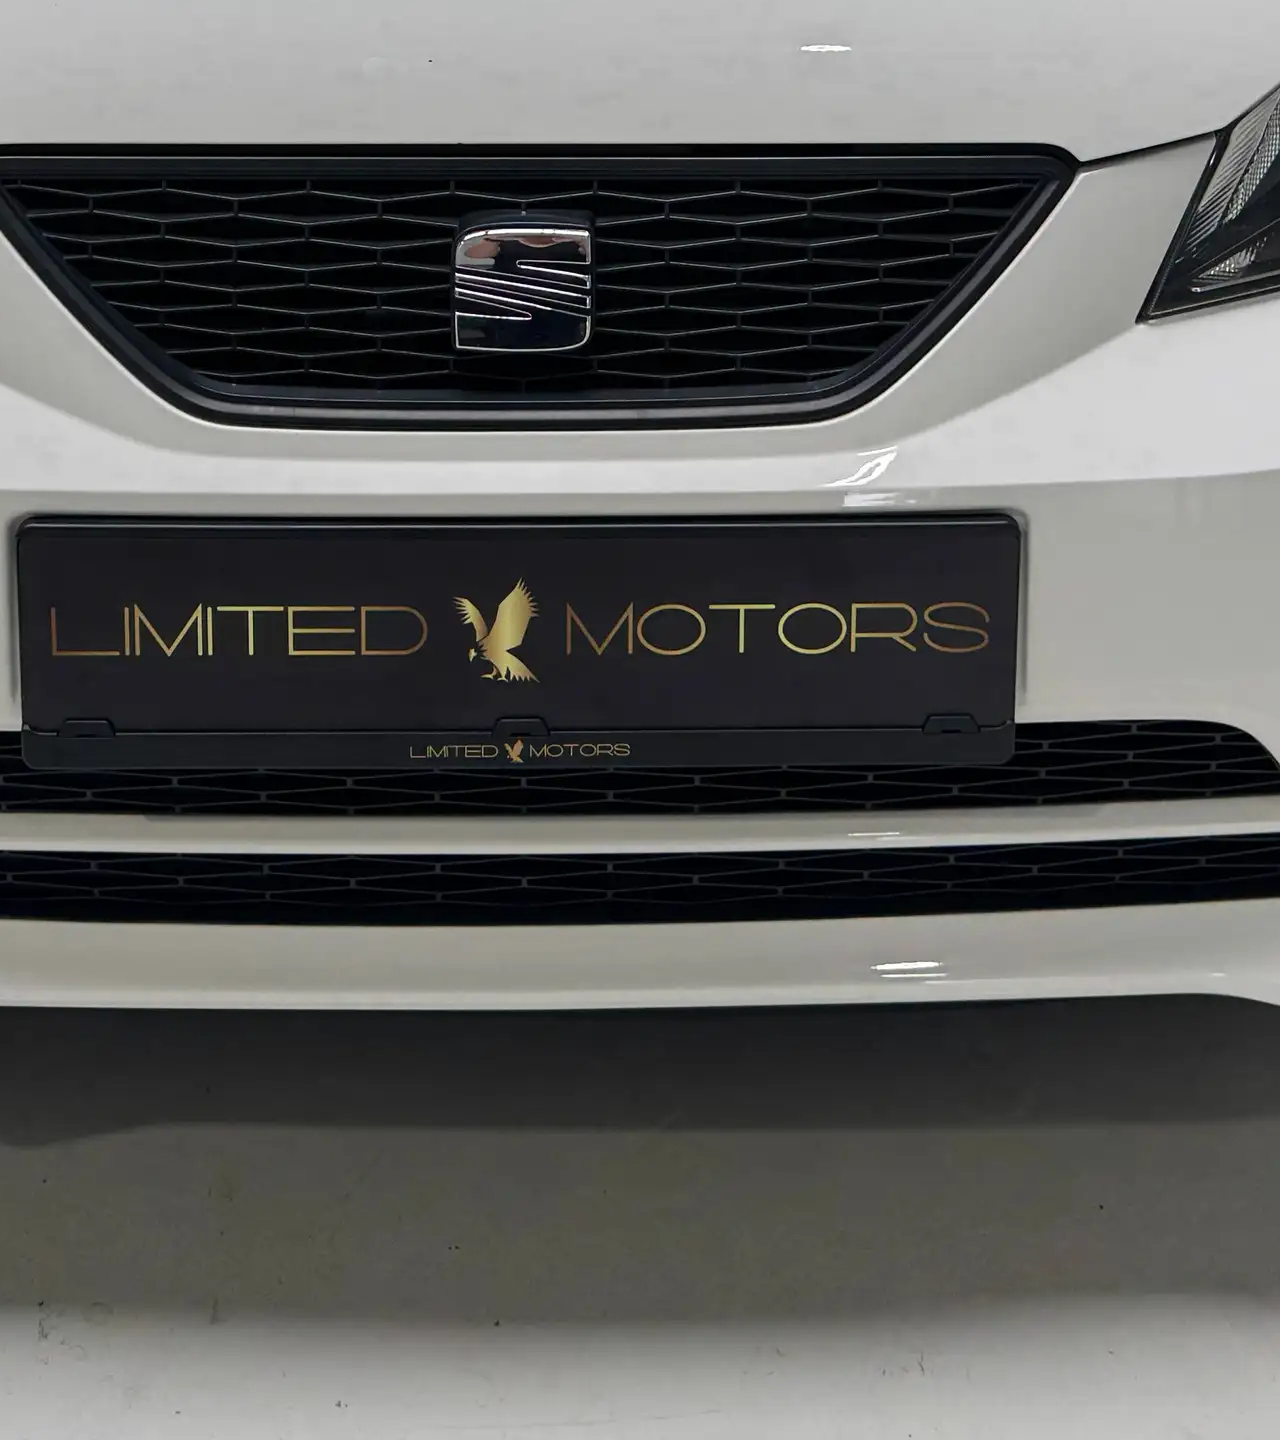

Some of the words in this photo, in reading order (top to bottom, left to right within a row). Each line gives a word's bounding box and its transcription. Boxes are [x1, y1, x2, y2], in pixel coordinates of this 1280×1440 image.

[49, 604, 429, 658] LIMITED
[564, 601, 991, 657] MOTORS
[409, 744, 499, 759] LIMITED
[529, 742, 631, 758] MOTORS
